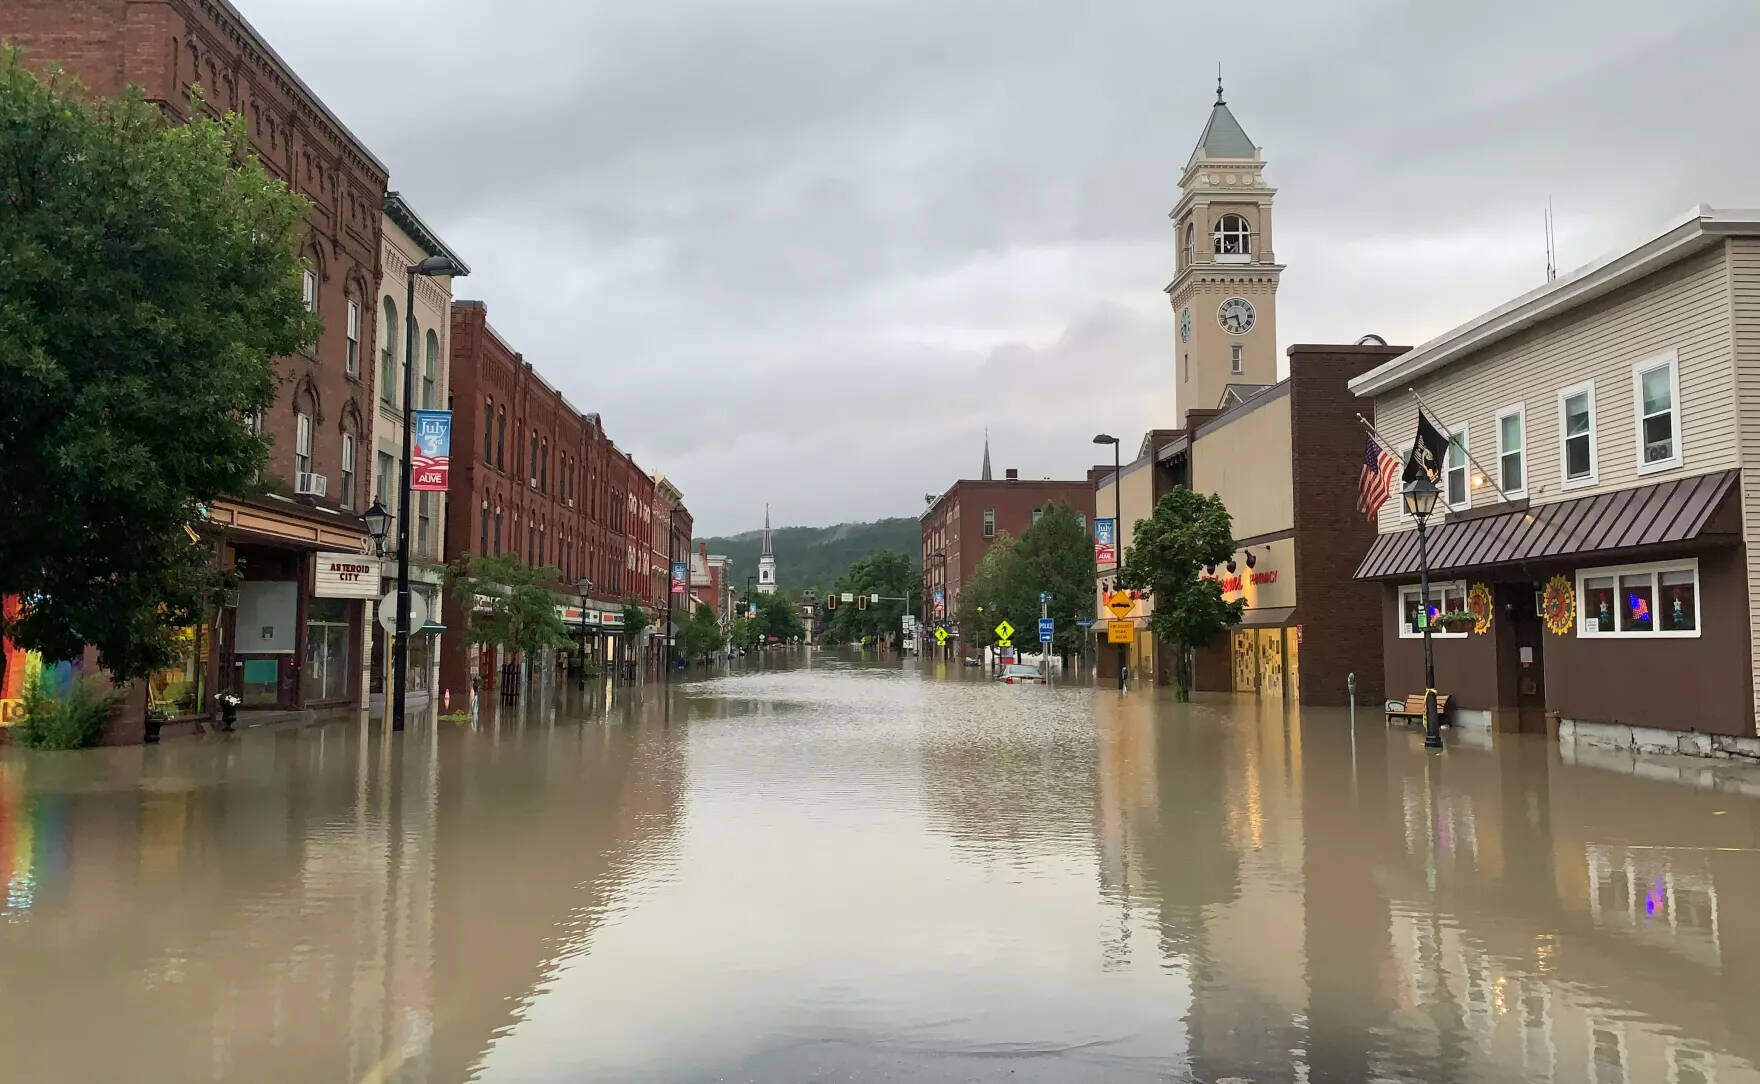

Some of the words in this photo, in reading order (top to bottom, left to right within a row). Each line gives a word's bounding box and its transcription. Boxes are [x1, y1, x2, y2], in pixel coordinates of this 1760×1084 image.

[419, 421, 447, 437] July
[419, 475, 442, 484] ALIVE
[1096, 523, 1112, 534] July
[330, 563, 370, 574] ASTEROID
[340, 573, 359, 581] CITY
